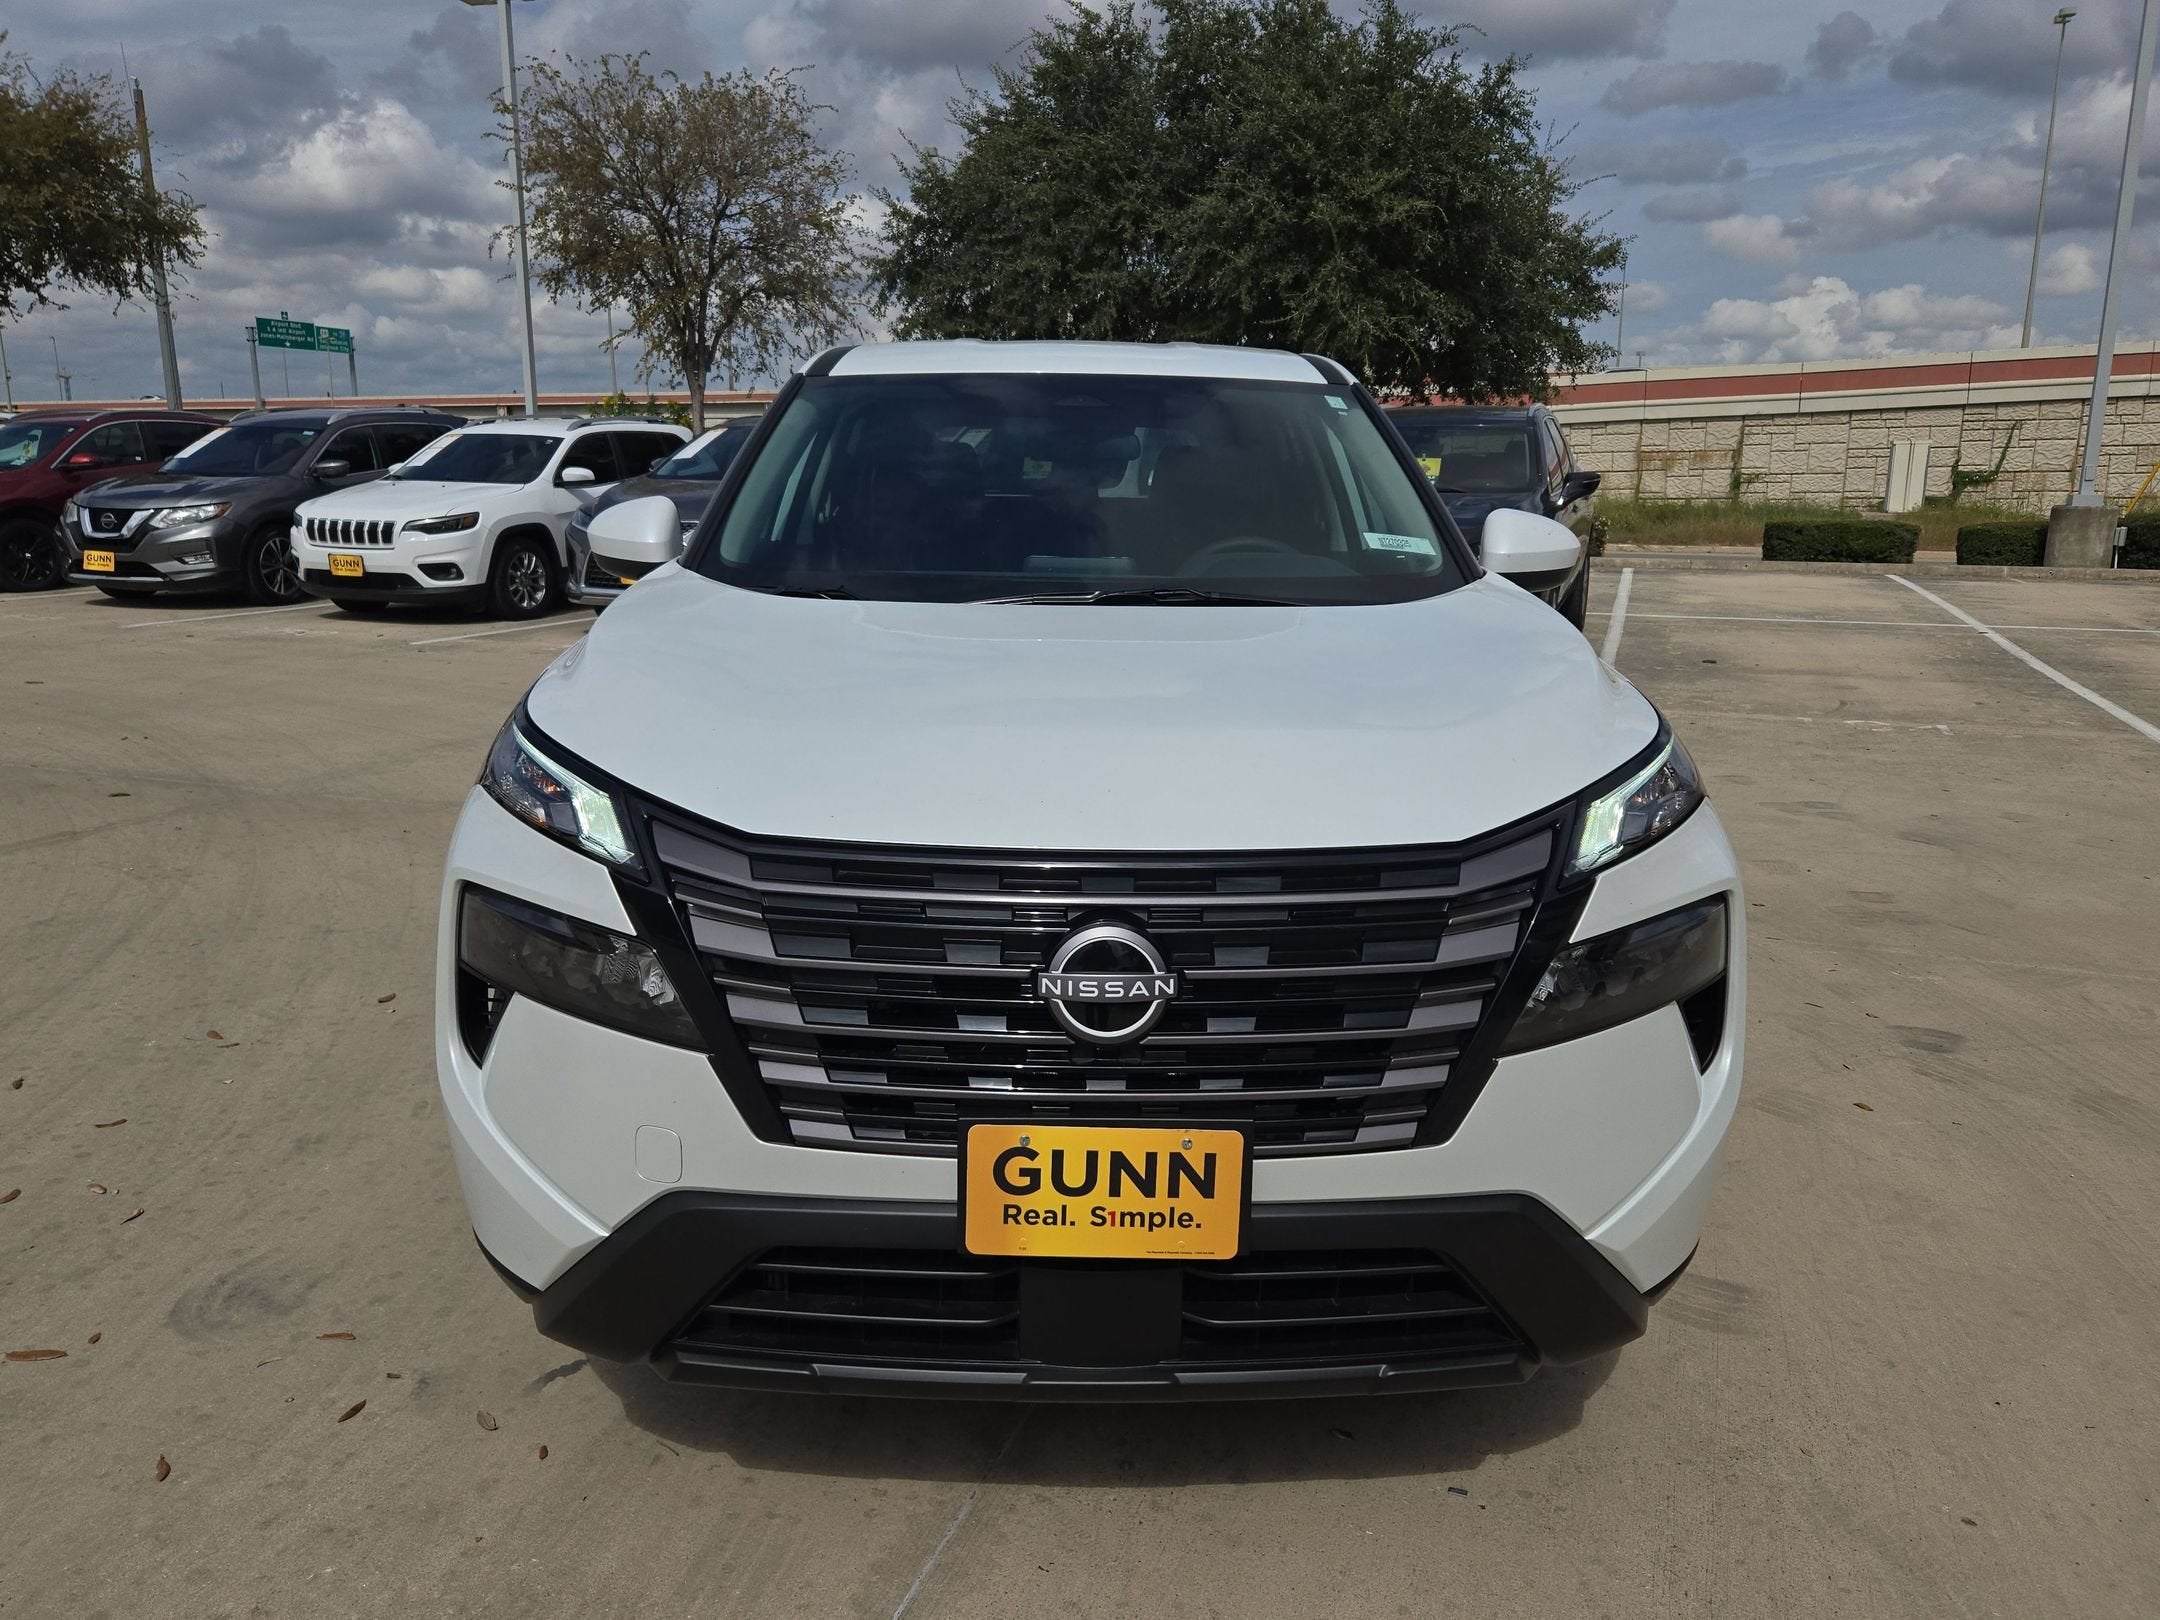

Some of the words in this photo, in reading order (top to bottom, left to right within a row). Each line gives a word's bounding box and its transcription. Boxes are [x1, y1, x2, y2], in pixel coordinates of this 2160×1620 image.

[271, 320, 289, 328] Airport
[87, 554, 112, 563] GUNN
[333, 559, 360, 568] GUNN
[1041, 978, 1175, 998] NISSAN
[992, 1146, 1217, 1200] GUNN
[1003, 1204, 1076, 1227] Real.
